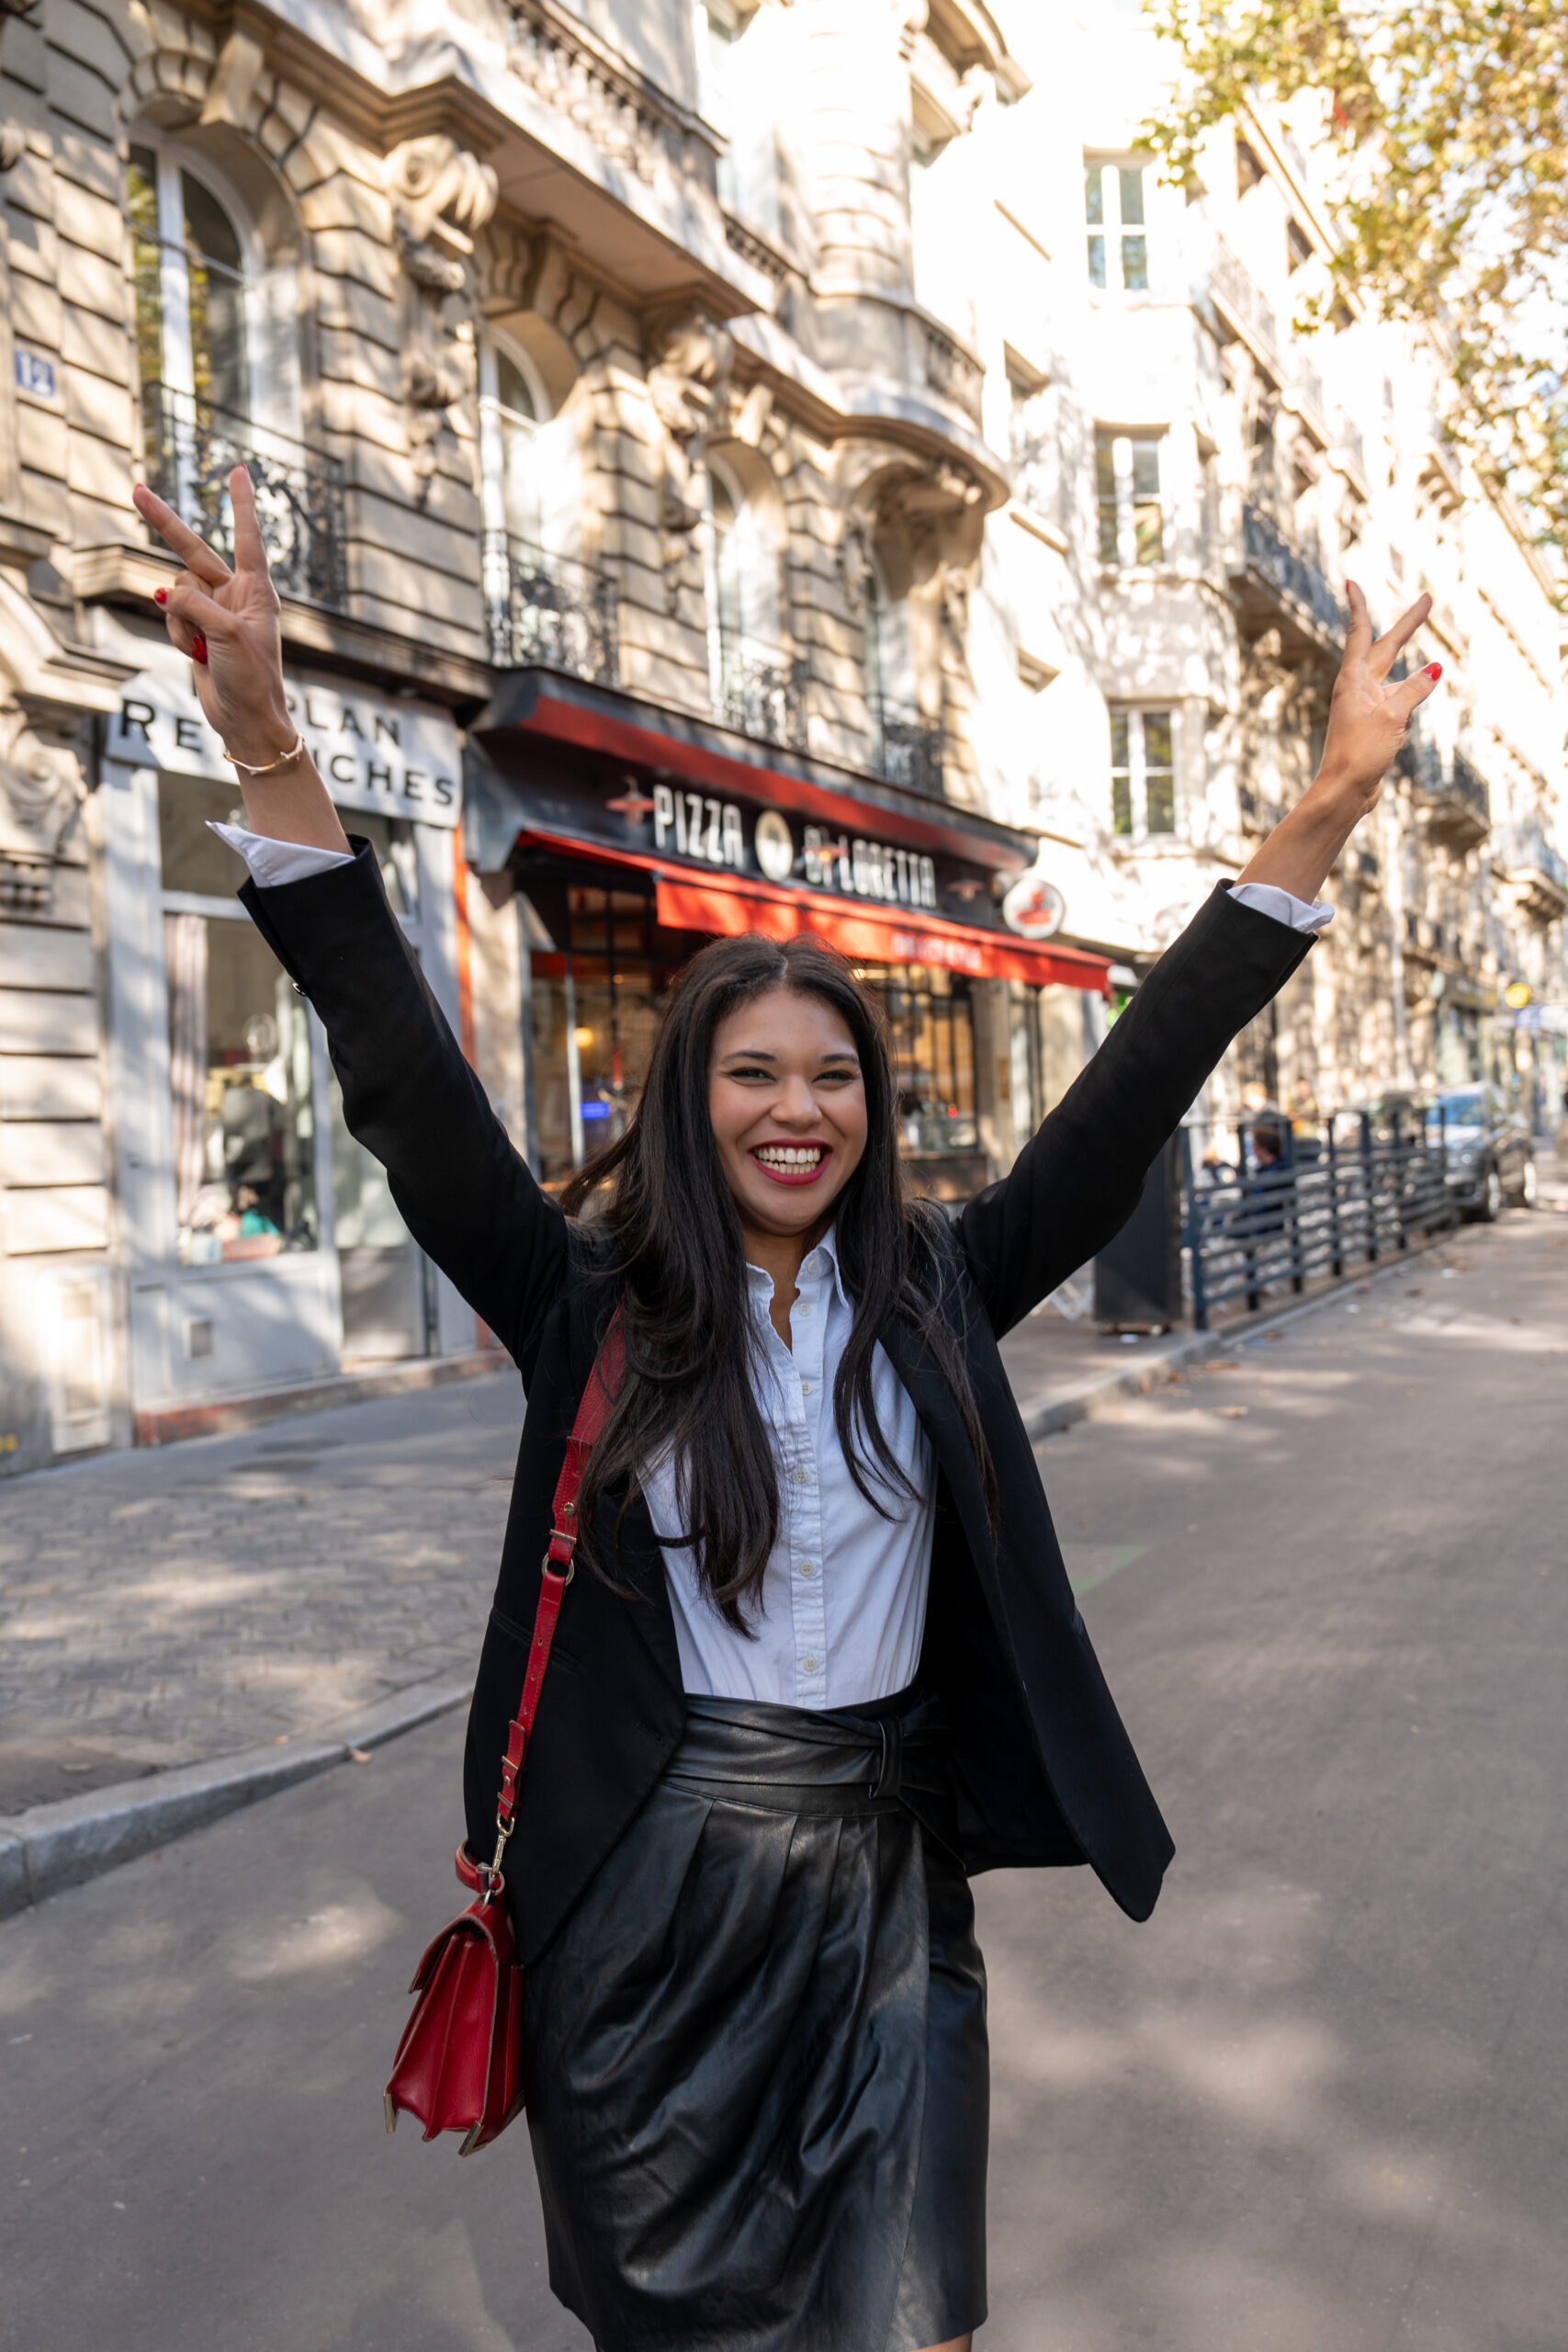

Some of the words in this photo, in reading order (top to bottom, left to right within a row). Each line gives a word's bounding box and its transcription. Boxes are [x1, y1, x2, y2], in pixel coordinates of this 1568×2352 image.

[119, 698, 454, 807] RECHES
[652, 784, 744, 870] PIZZA
[838, 834, 937, 908] LORETTA
